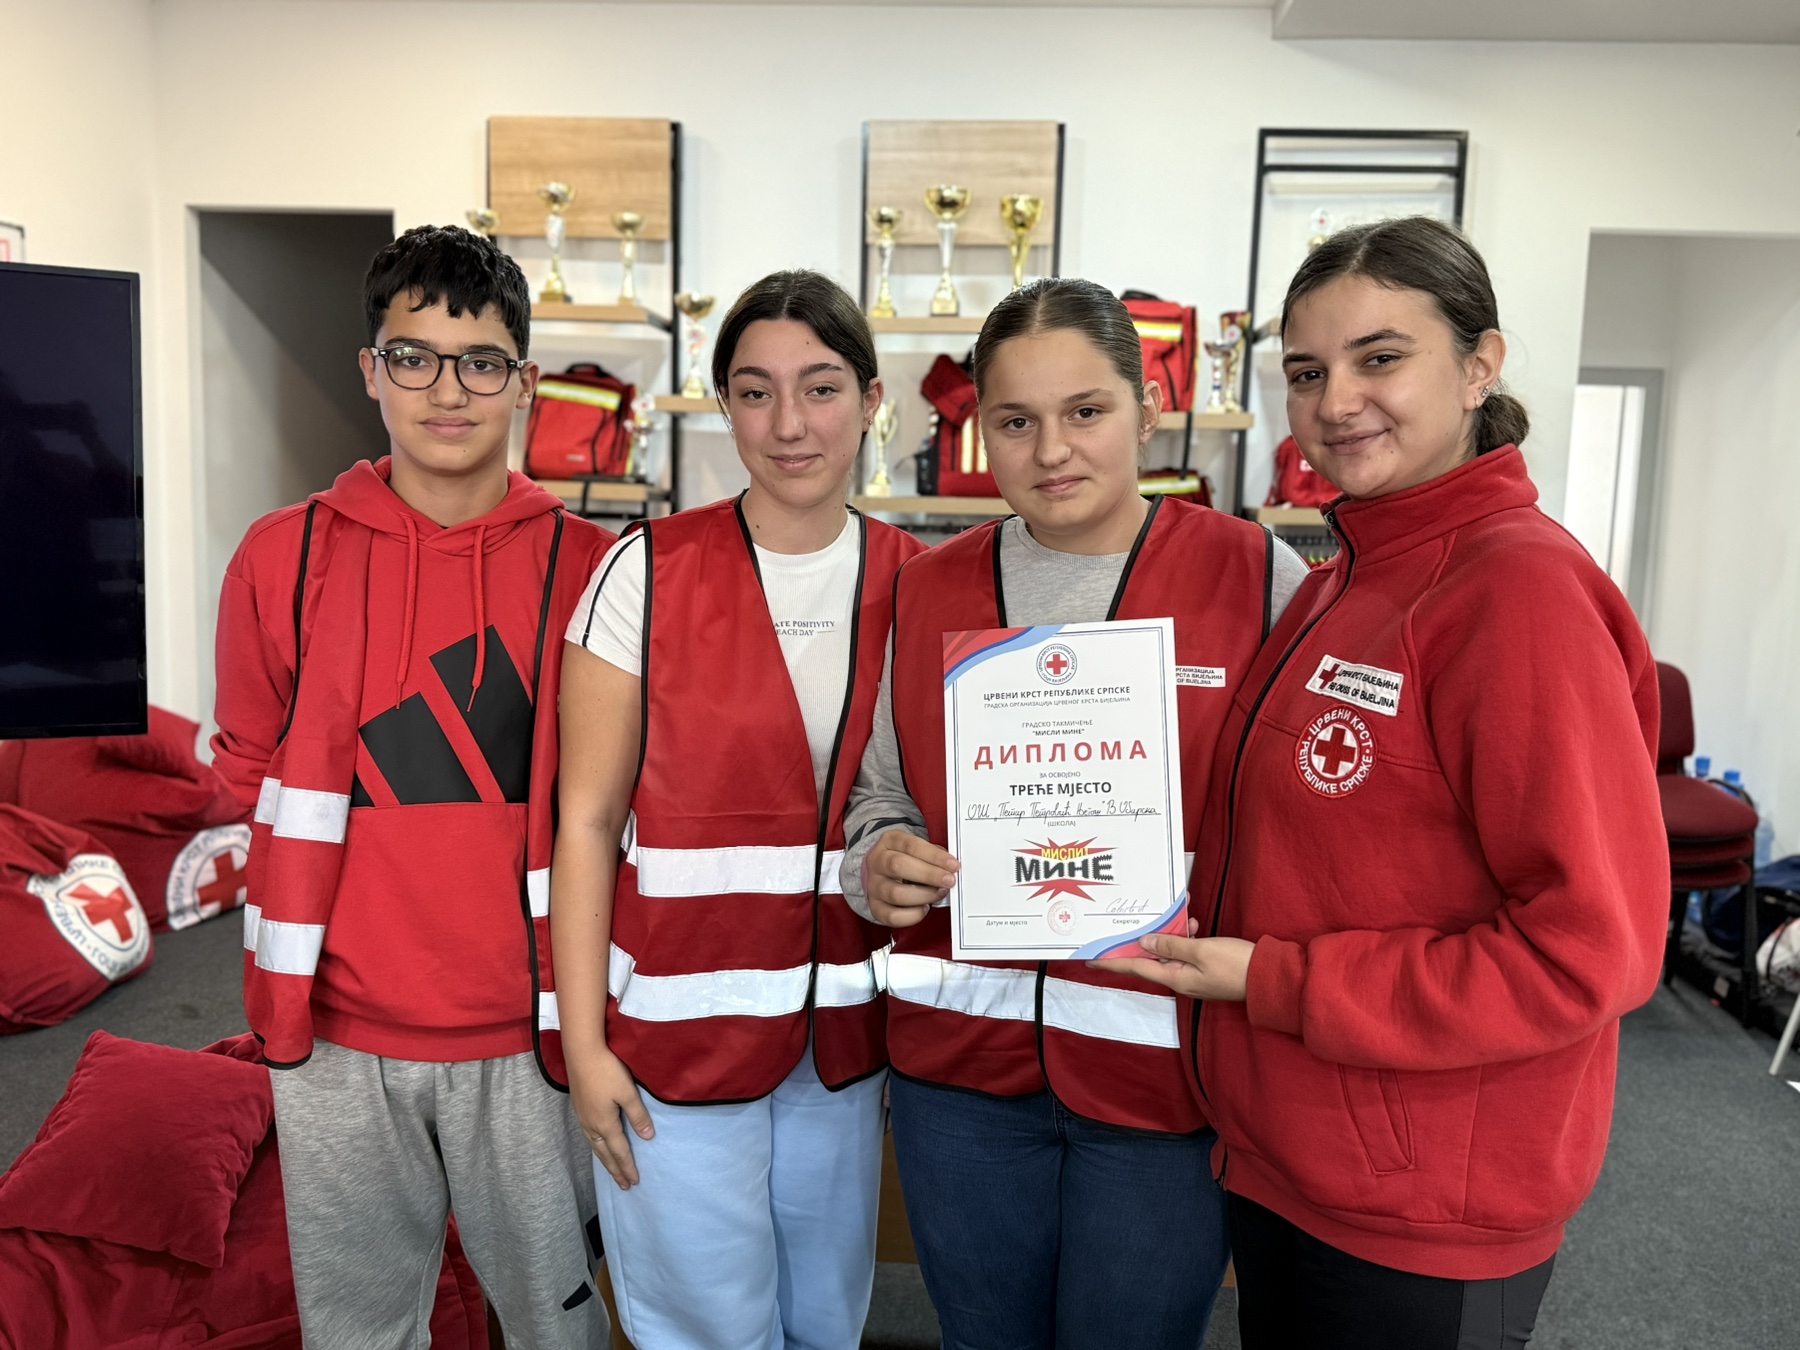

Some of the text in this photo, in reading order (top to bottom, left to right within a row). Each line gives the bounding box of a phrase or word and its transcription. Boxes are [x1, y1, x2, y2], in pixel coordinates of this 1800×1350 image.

[793, 620, 835, 628] POSITIVITY
[984, 686, 1131, 702] ЦРВЕНИ КРСТ РЕПУБЛИКЕ СРПСКЕ
[1351, 688, 1360, 697] OF
[1022, 721, 1051, 729] ГРАДСКО
[1310, 709, 1373, 748] ЦРВЕНИ КРСТ
[974, 740, 1148, 770] ДИПЛОМА
[1298, 741, 1373, 794] РЕПУБЛИКЕ СРПСКЕ
[1010, 782, 1112, 797] ТРЕЋЕ МЈЕСТО
[1014, 854, 1114, 883] МИНЕ
